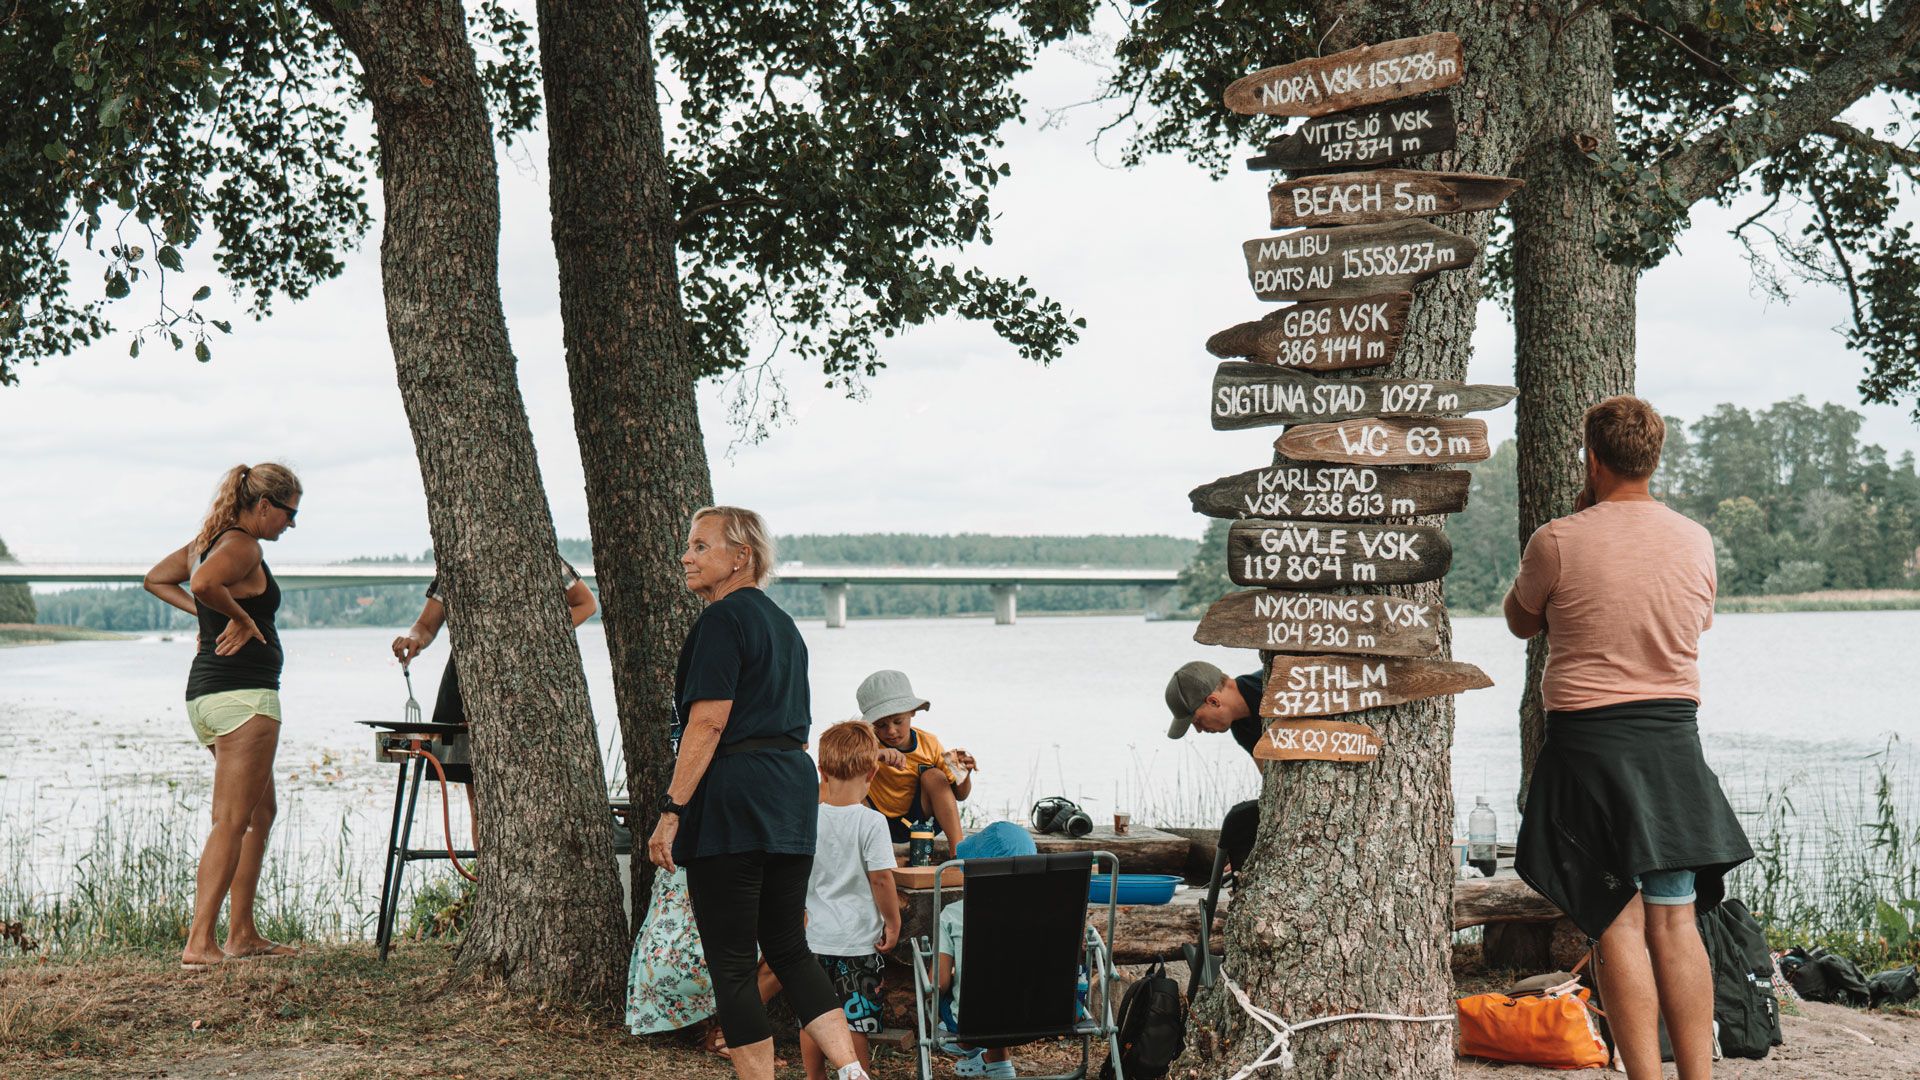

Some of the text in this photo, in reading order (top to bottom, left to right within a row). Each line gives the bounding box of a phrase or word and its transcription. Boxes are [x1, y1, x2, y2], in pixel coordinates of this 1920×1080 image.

[1262, 74, 1320, 108] NORA
[1320, 63, 1362, 96] VSK
[1301, 109, 1433, 145] VITTSJÖ VSK
[1401, 137, 1421, 152] m
[1292, 183, 1380, 217] BEACH
[1257, 234, 1330, 263] MALIBU
[1254, 265, 1333, 294] BOATS AU
[1283, 302, 1389, 337] GBG VSK
[1366, 340, 1385, 359] m
[1215, 383, 1459, 417] SIGTUNA STAD 1097 m
[1337, 425, 1471, 457] WC 63 m
[1256, 467, 1378, 494] KARLSTAD
[1244, 492, 1292, 516] VSK
[1391, 498, 1416, 516] m
[1260, 521, 1421, 562] GÄVLE VSK
[1352, 562, 1377, 582] m
[1254, 592, 1430, 628] NYKÖPINGS VSK
[1357, 633, 1376, 648] m
[1287, 662, 1388, 691] STHLM
[1273, 690, 1382, 717] 37214 m
[1267, 727, 1301, 750] VSK
